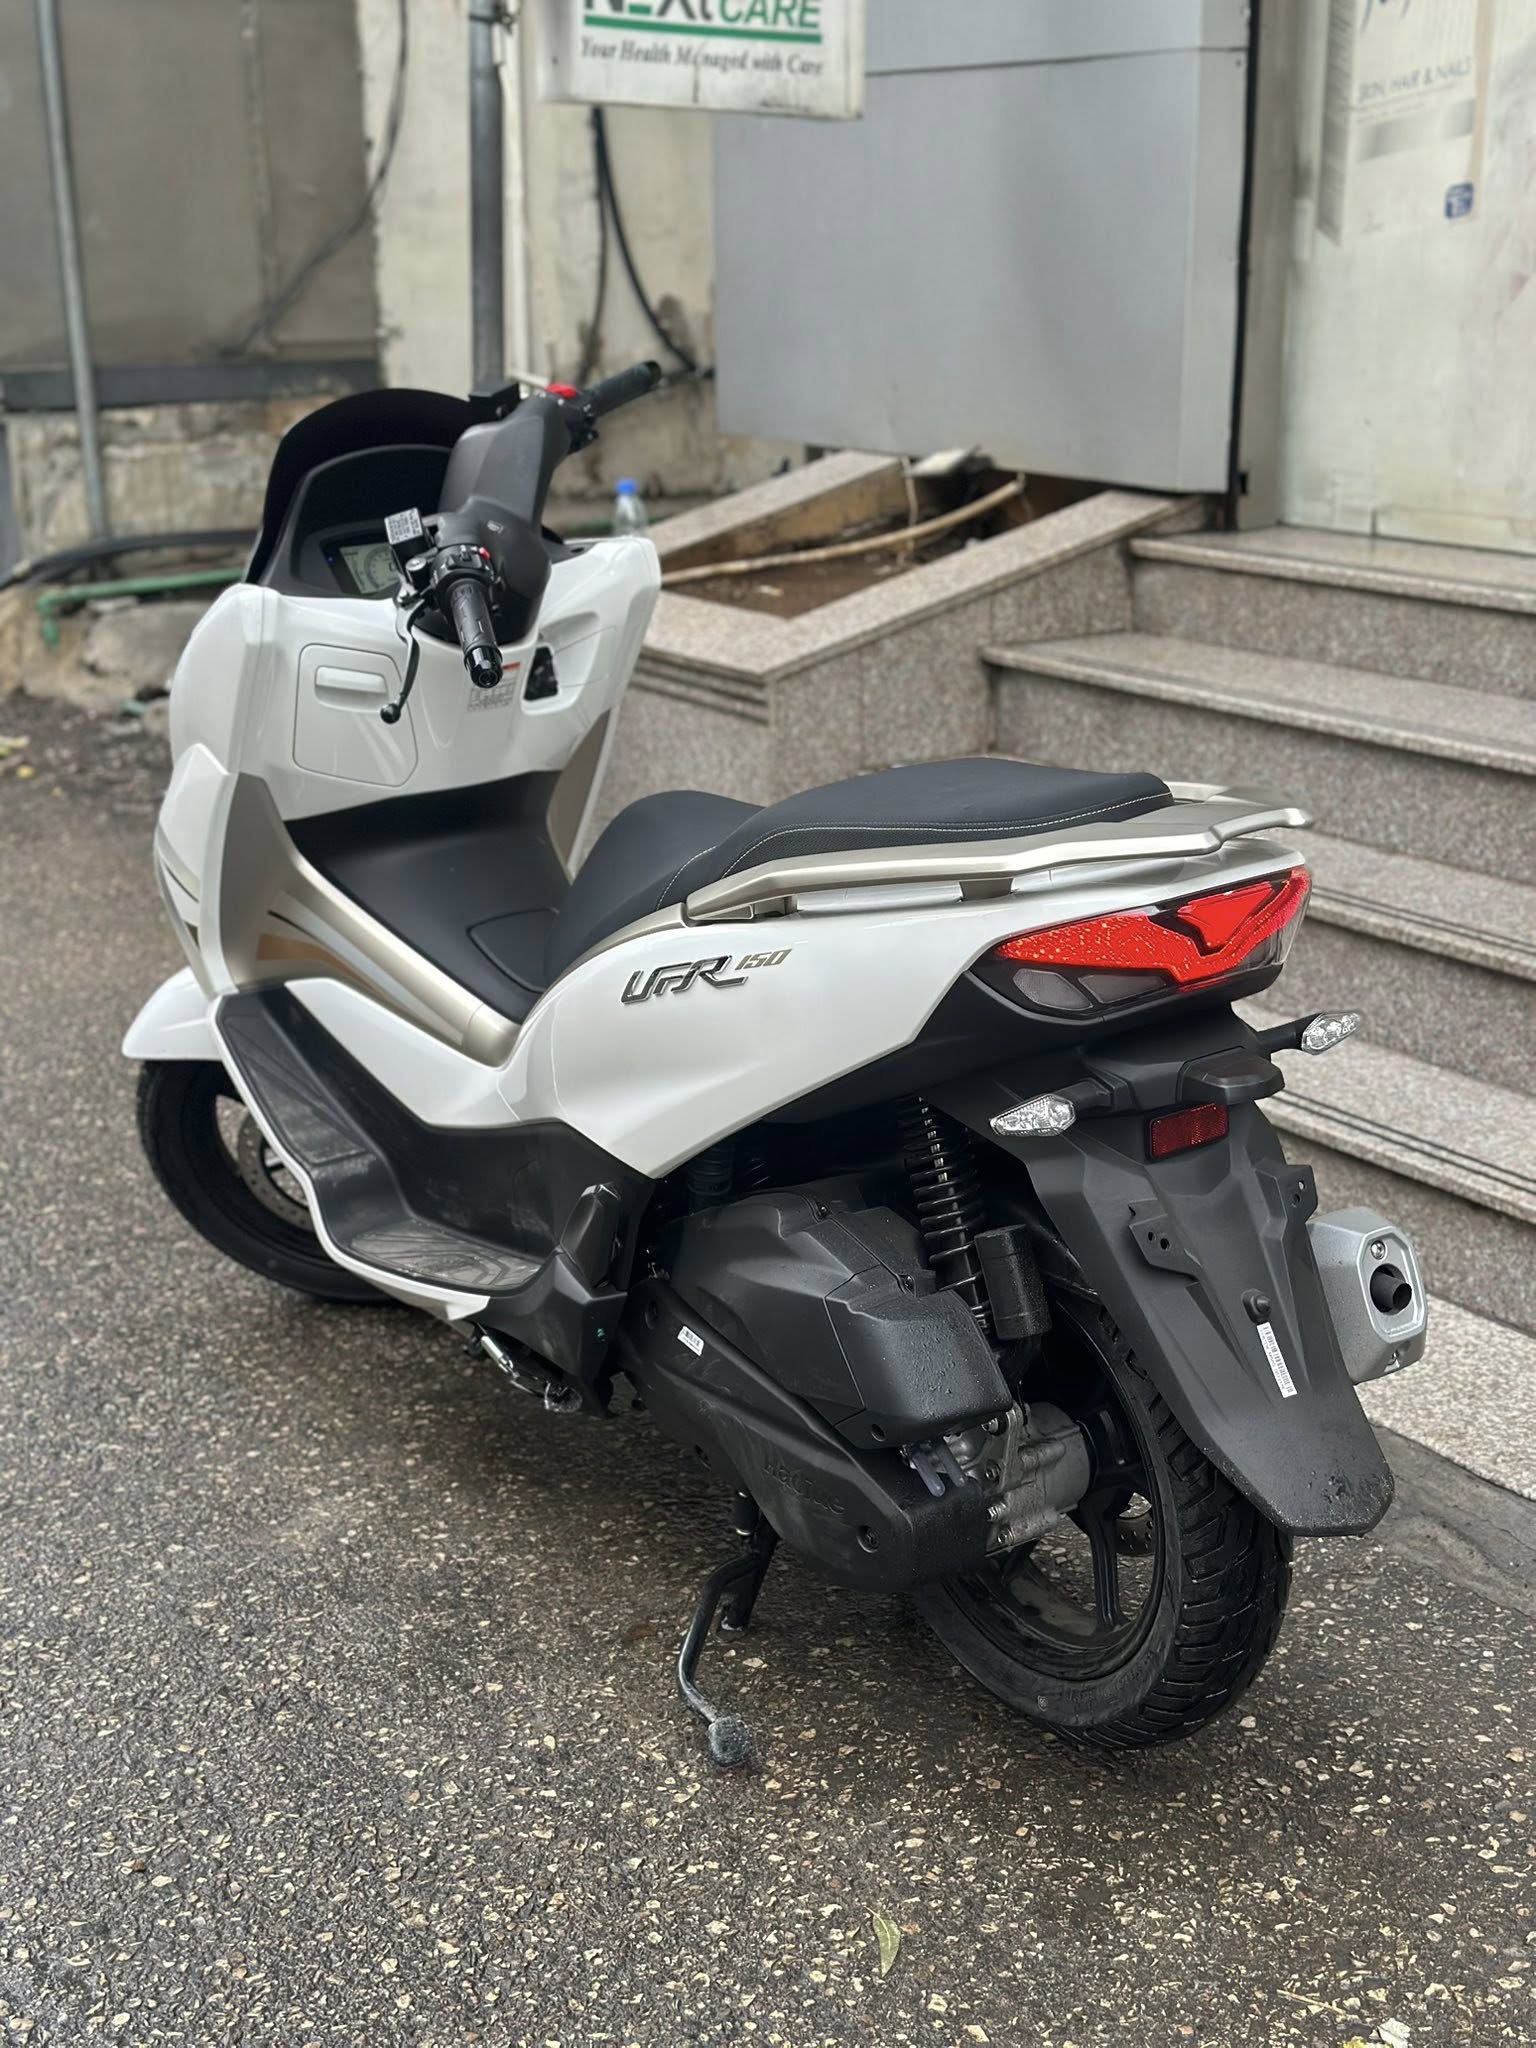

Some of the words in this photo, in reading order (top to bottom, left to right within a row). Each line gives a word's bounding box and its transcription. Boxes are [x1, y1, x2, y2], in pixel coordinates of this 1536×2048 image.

[582, 36, 617, 58] Your
[619, 39, 671, 63] Health
[674, 45, 748, 73] Managed
[753, 51, 783, 71] with
[787, 54, 823, 75] Care
[621, 955, 749, 1004] UFR
[735, 949, 792, 970] 150
